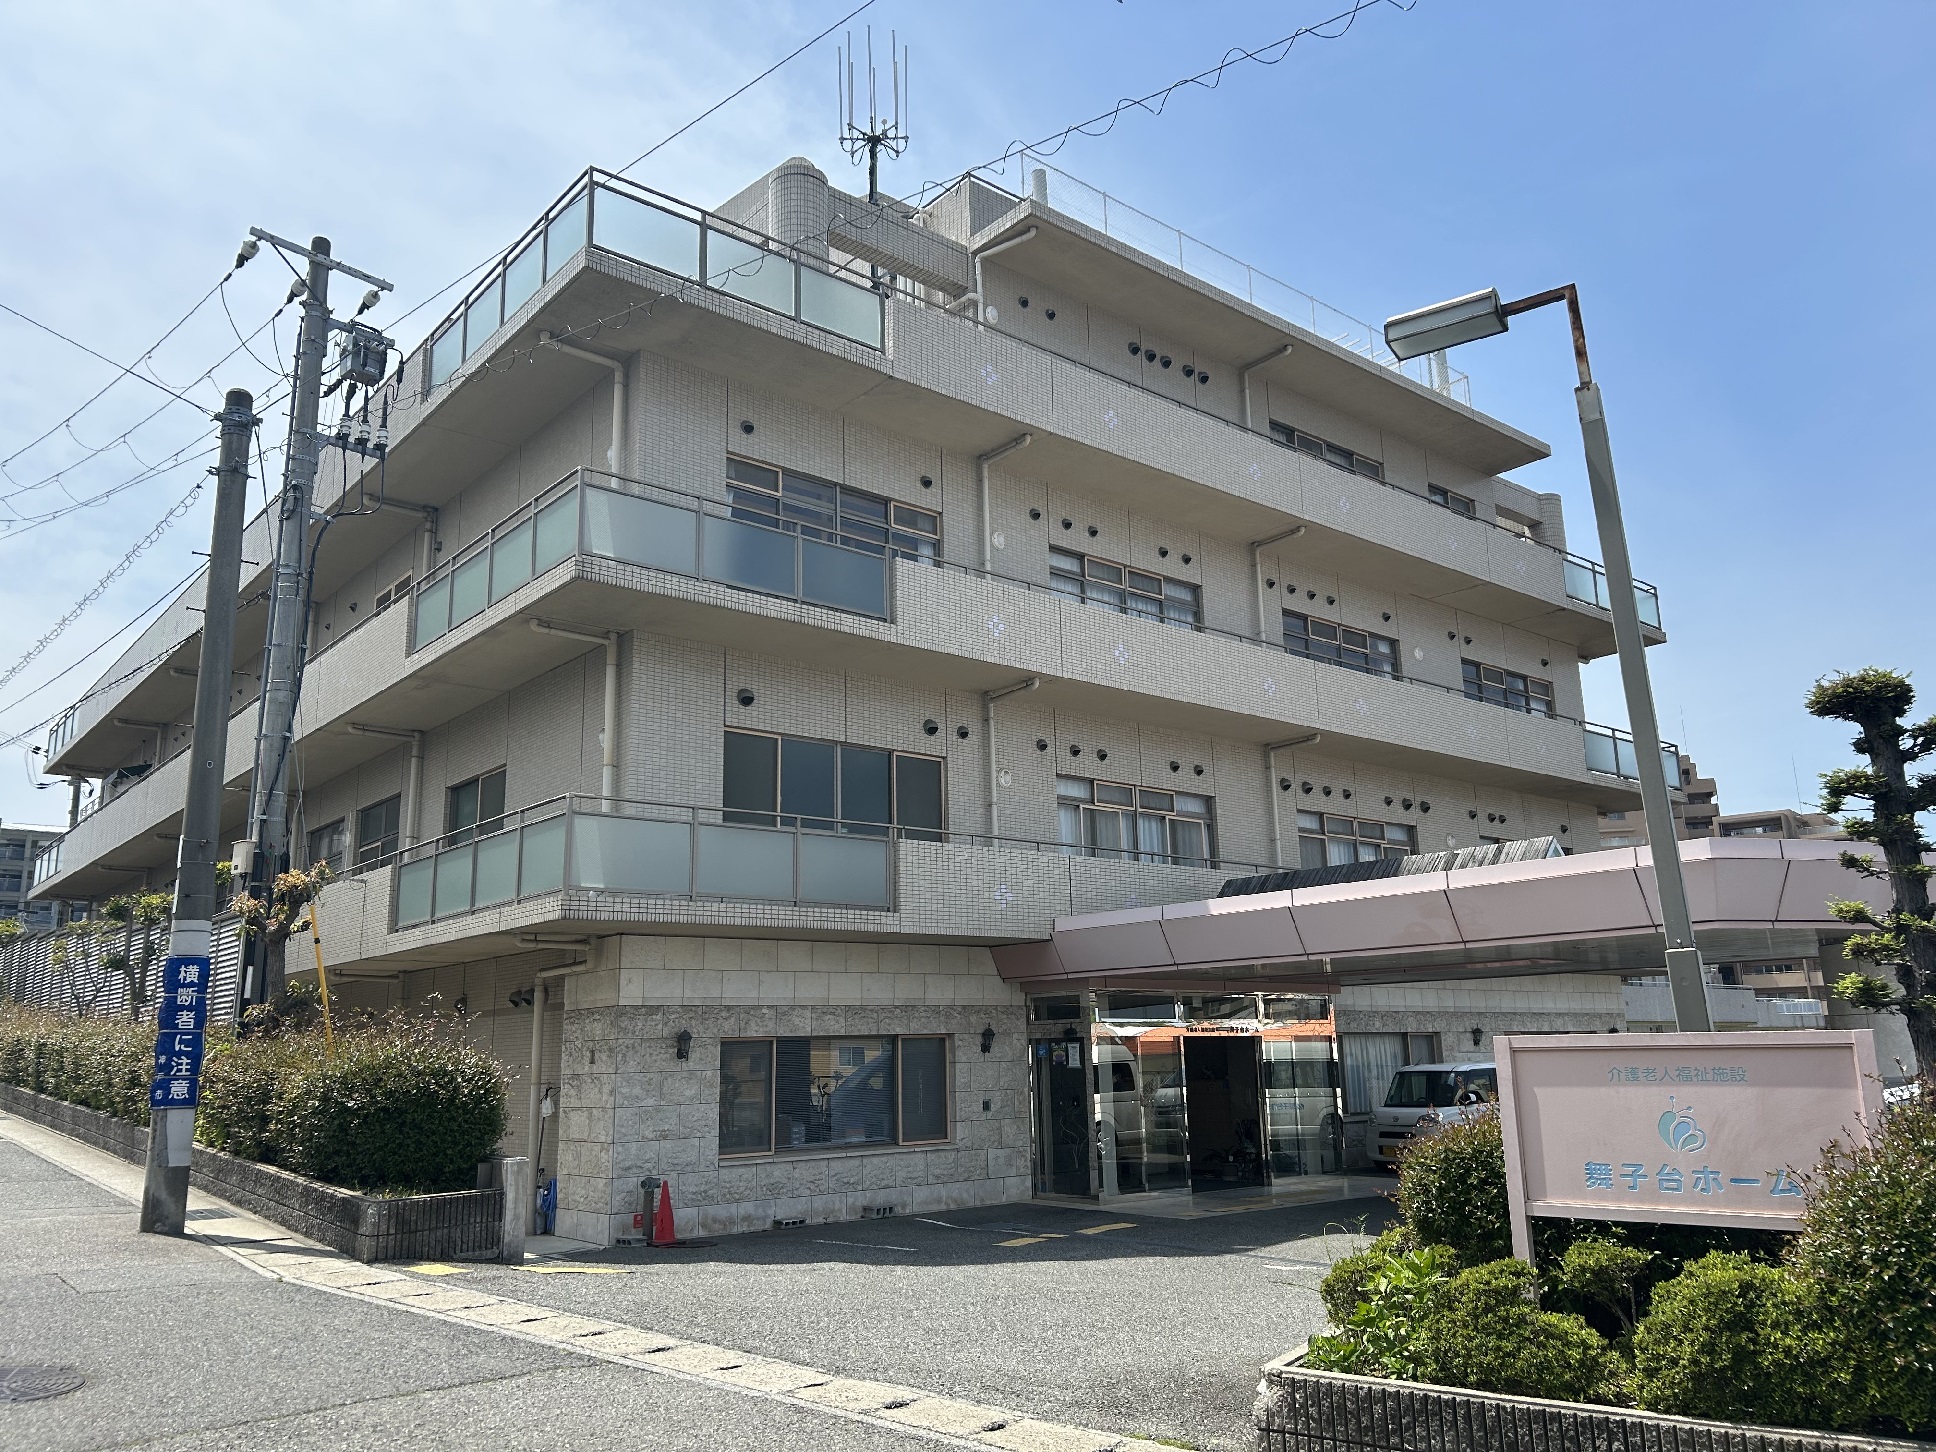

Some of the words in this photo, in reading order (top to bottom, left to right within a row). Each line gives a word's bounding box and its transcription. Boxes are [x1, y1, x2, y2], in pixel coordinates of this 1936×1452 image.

[168, 964, 200, 1100] 横断者に注意
[154, 1055, 167, 1100] 神戸市
[1607, 1066, 1749, 1083] 介護老人福祉施設
[1584, 1160, 1804, 1197] 舞子台ホーム
